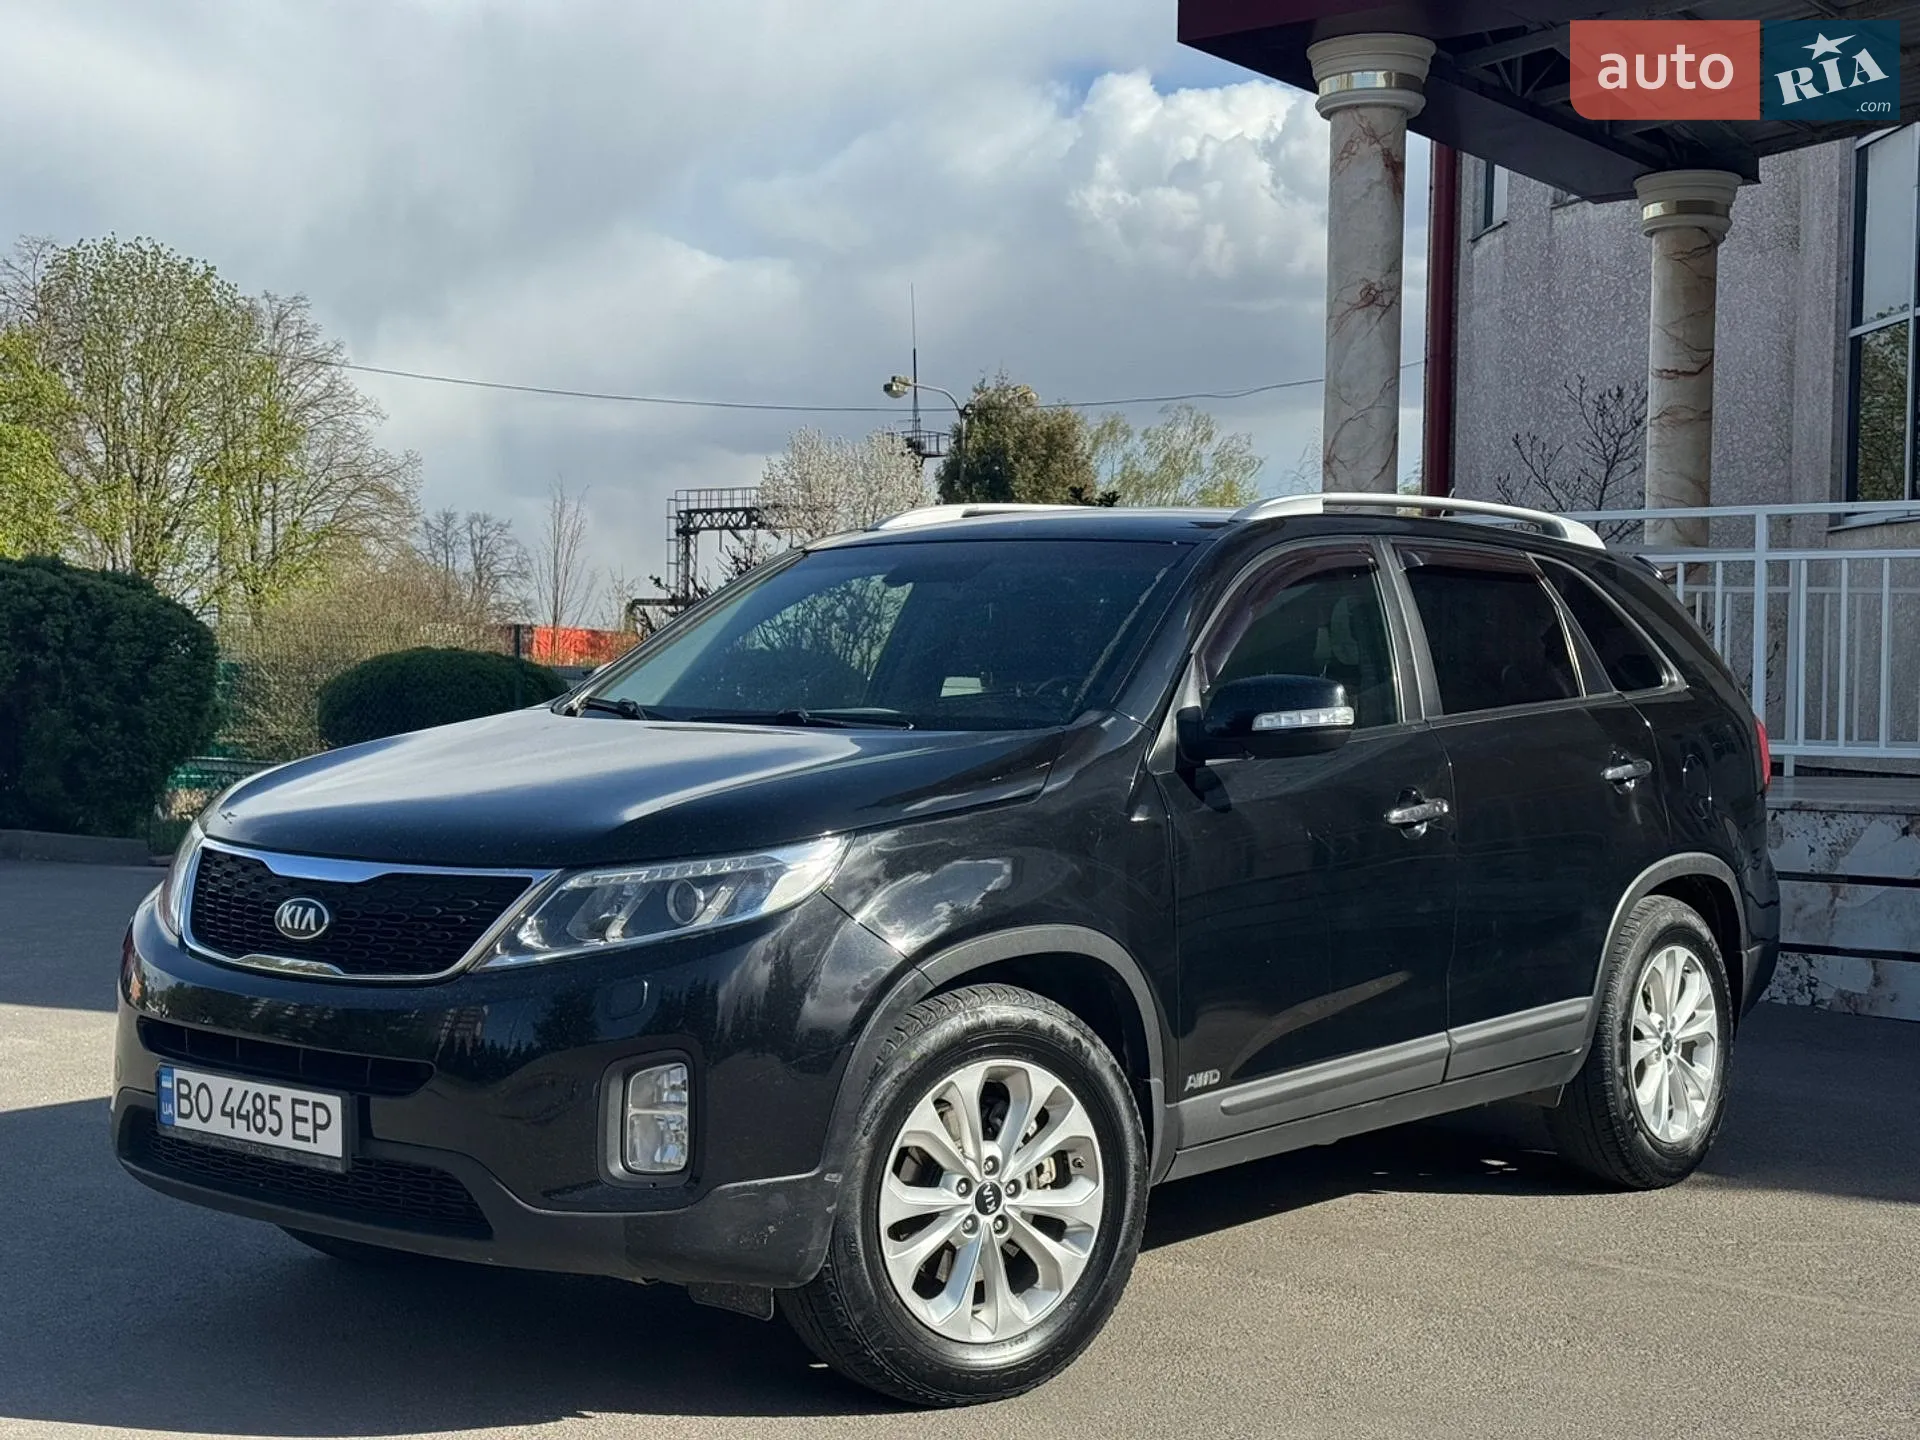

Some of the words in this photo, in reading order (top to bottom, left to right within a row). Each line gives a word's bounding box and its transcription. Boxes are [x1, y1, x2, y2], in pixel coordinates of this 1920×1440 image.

[280, 904, 316, 931] KIA
[1183, 1068, 1221, 1092] AWD
[176, 1077, 213, 1124] BO
[220, 1086, 283, 1137] 4485
[290, 1097, 332, 1144] EP
[982, 1182, 997, 1213] KIA
